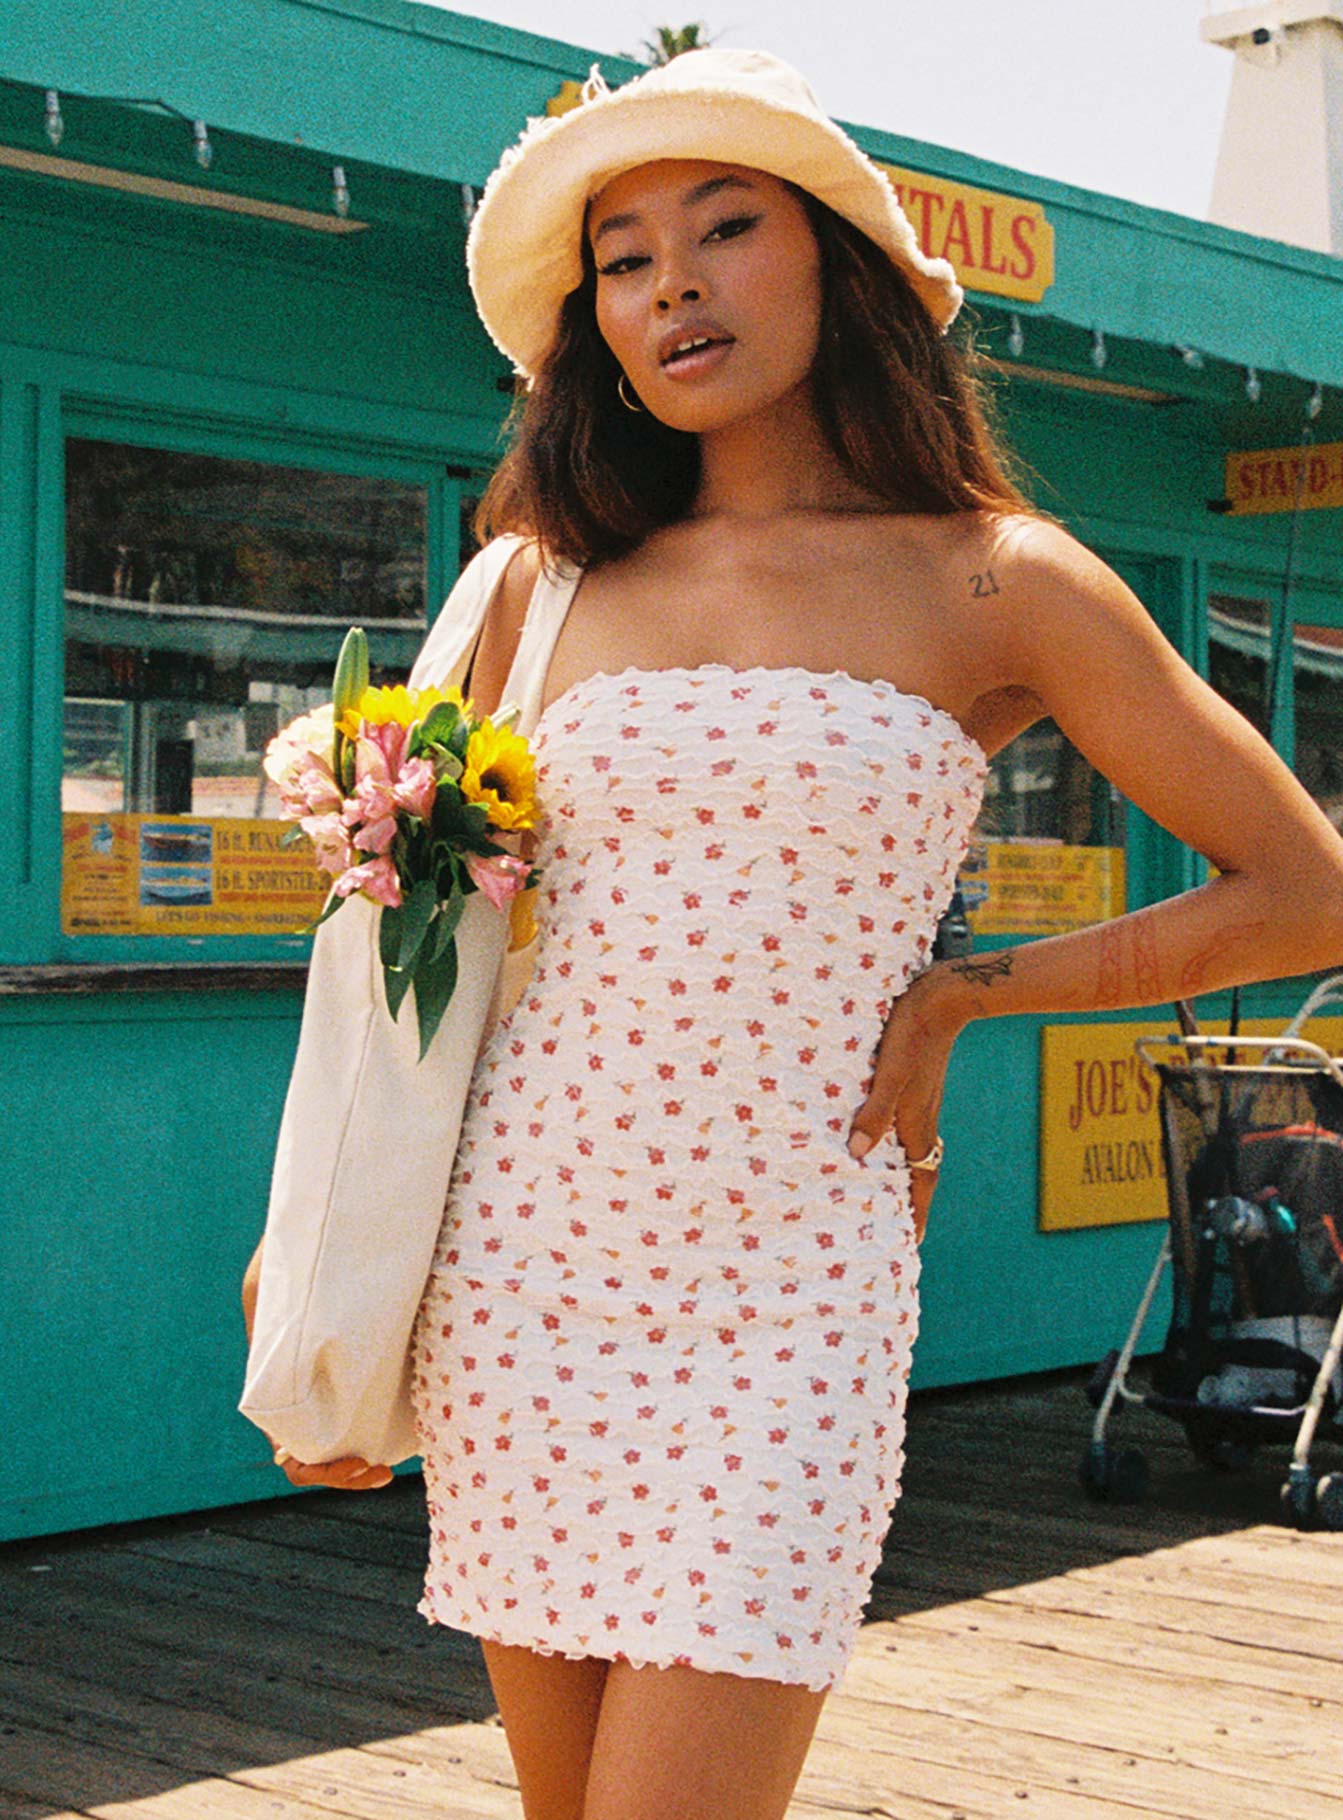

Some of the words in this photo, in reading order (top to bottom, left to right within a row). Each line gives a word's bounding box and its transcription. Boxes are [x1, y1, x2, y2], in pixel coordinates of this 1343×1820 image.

[895, 184, 1036, 280] TALS
[1069, 1055, 1153, 1130] JOE'S
[1081, 1141, 1153, 1184] AVALON
